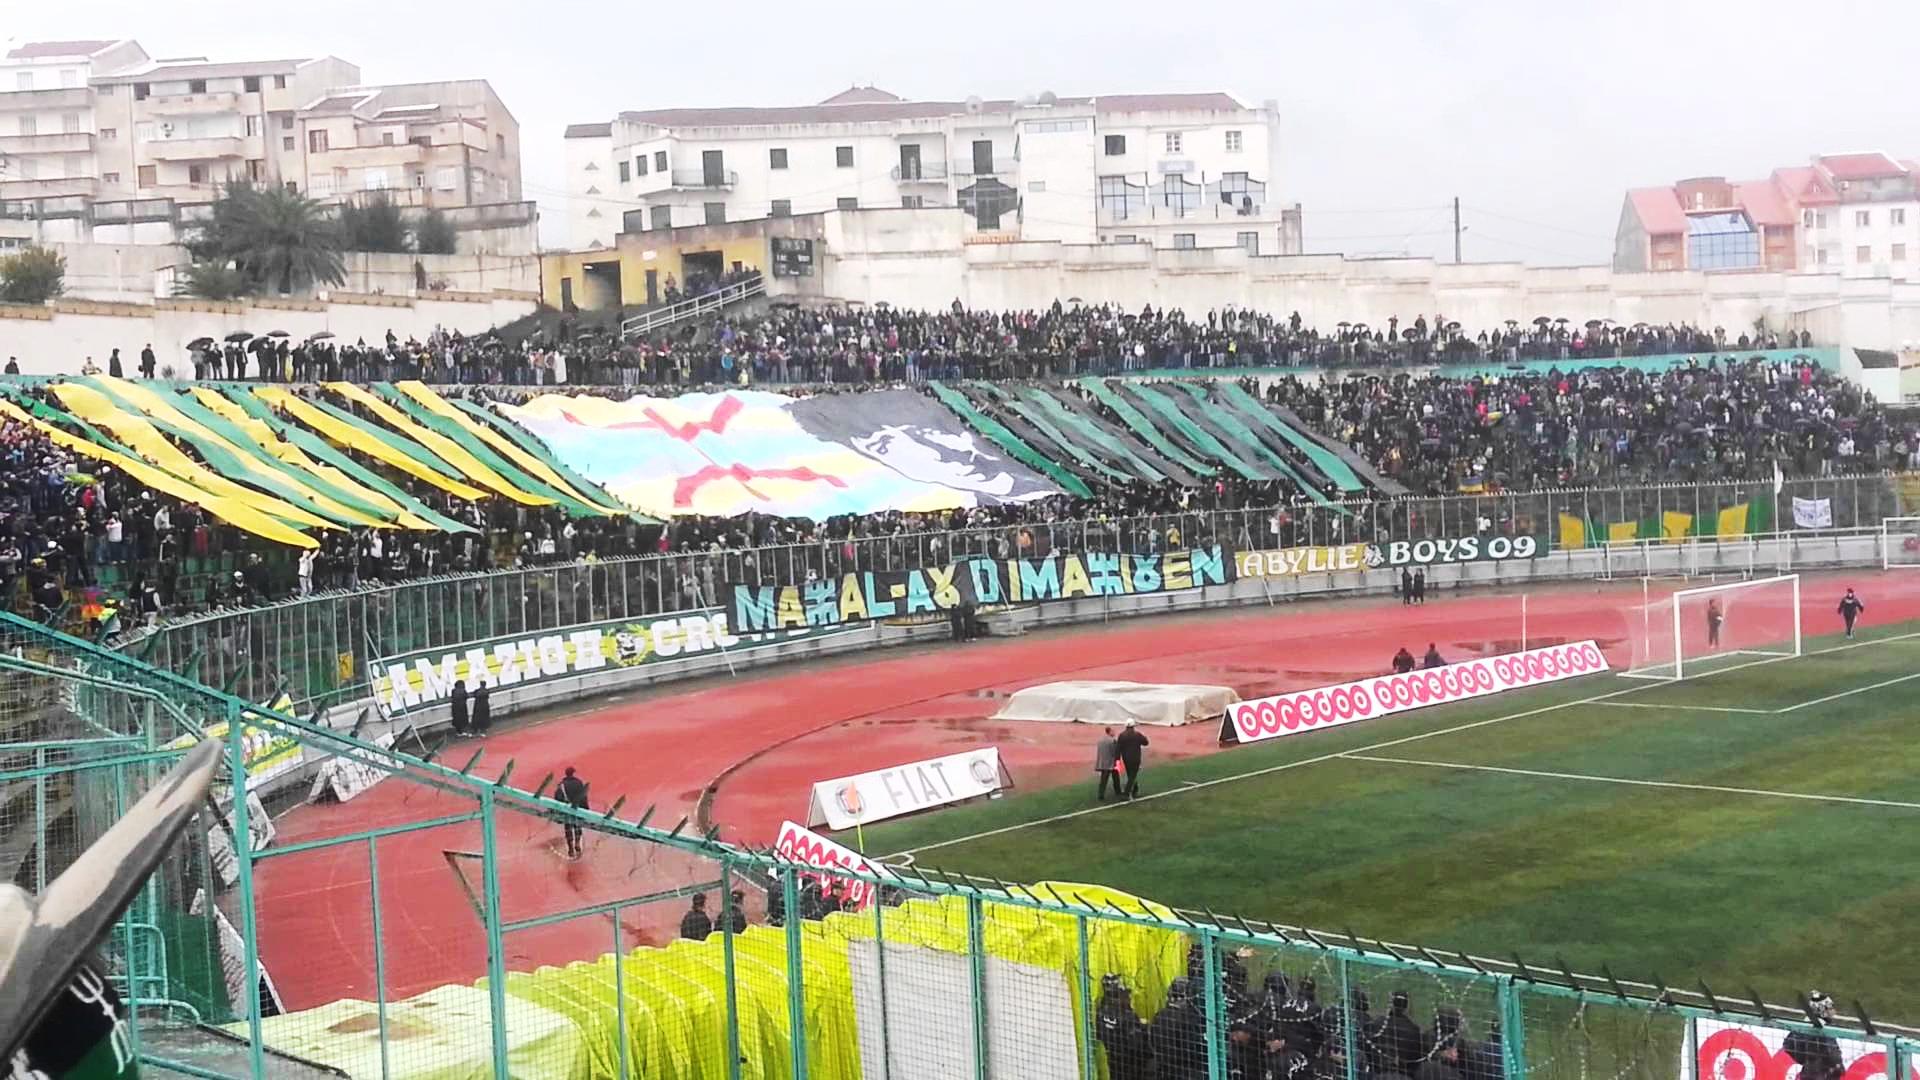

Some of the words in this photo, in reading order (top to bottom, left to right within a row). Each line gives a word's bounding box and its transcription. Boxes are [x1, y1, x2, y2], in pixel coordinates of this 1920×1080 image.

[1235, 545, 1358, 578] ABYLIE
[1389, 536, 1480, 564] BOYS
[1487, 535, 1537, 560] 09
[387, 629, 607, 712] AMAZIGH
[1238, 685, 1372, 737] ooredoo
[1374, 663, 1495, 710] ooredoo
[1495, 643, 1602, 686] ooredoo
[880, 762, 955, 809] FIAT
